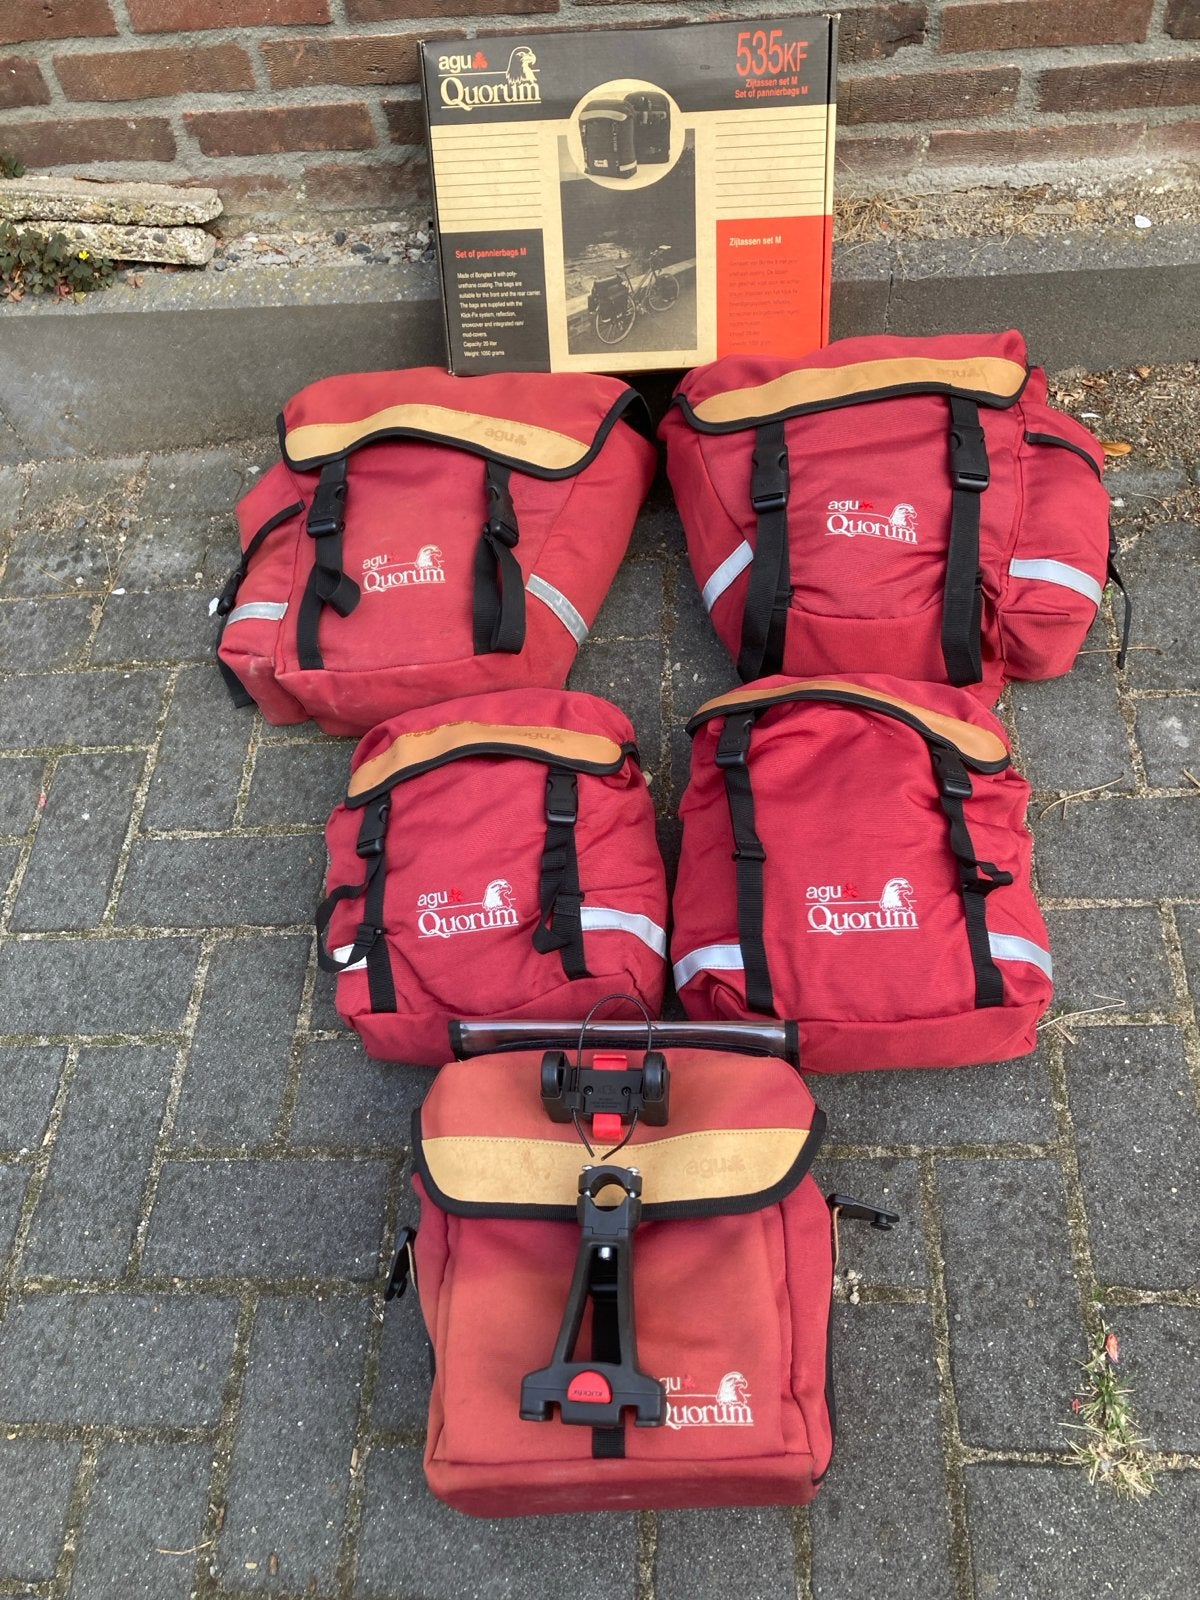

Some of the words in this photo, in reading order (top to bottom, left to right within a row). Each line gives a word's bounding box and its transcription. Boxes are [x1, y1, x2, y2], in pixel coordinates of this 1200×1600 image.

[736, 29, 809, 76] 535KF
[438, 54, 472, 73] agu
[735, 89, 747, 98] Set
[756, 87, 799, 99] pannierbags
[801, 85, 808, 94] M
[745, 79, 777, 89] Zijtassen
[779, 77, 790, 86] set
[791, 76, 798, 85] M
[440, 77, 542, 111] Quorum
[729, 237, 761, 248] Zijtassen
[763, 236, 773, 245] set
[775, 235, 782, 244] M
[455, 250, 467, 259] Set
[468, 250, 475, 258] of
[477, 248, 518, 259] pannierbags
[520, 247, 527, 256] M
[484, 427, 514, 442] agu
[827, 499, 860, 512] agu
[826, 514, 918, 543] Quorum
[362, 553, 388, 571] agu
[363, 567, 445, 592] Quorum
[417, 889, 448, 909] agu
[805, 885, 842, 902] agu
[417, 908, 520, 938] Quorum
[807, 904, 919, 936] Quorum
[683, 1157, 727, 1179] agu
